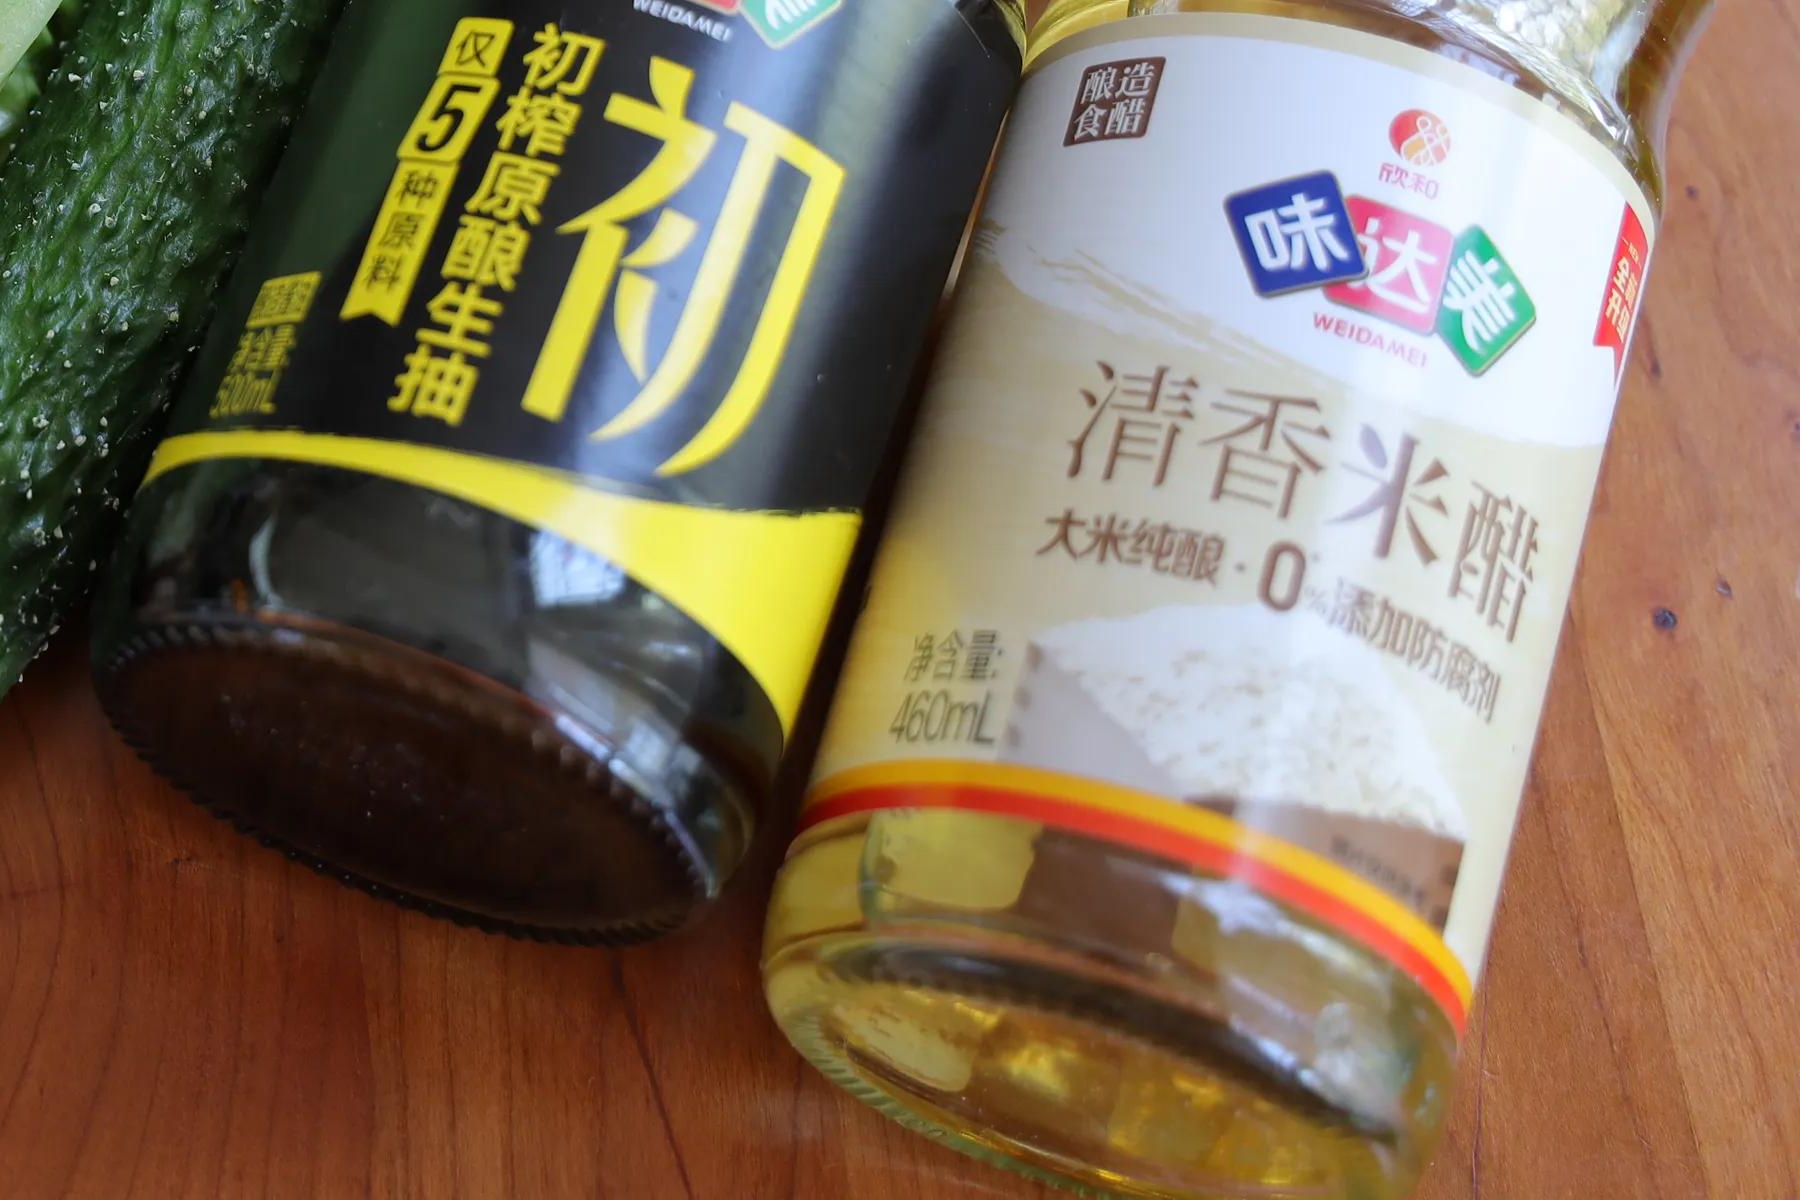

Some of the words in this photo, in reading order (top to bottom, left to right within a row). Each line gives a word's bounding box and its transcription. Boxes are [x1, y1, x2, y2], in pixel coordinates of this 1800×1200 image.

[1080, 61, 1155, 105] 酿造
[1073, 97, 1146, 141] 食醋
[1378, 161, 1440, 200] 欣和
[386, 22, 607, 427] 初榨原酿生抽
[521, 54, 847, 479] 初
[1244, 192, 1518, 357] 味达美
[1312, 311, 1428, 369] WEIDAMEI
[1066, 360, 1539, 645] 清香米醋
[888, 688, 996, 745] 460mL
